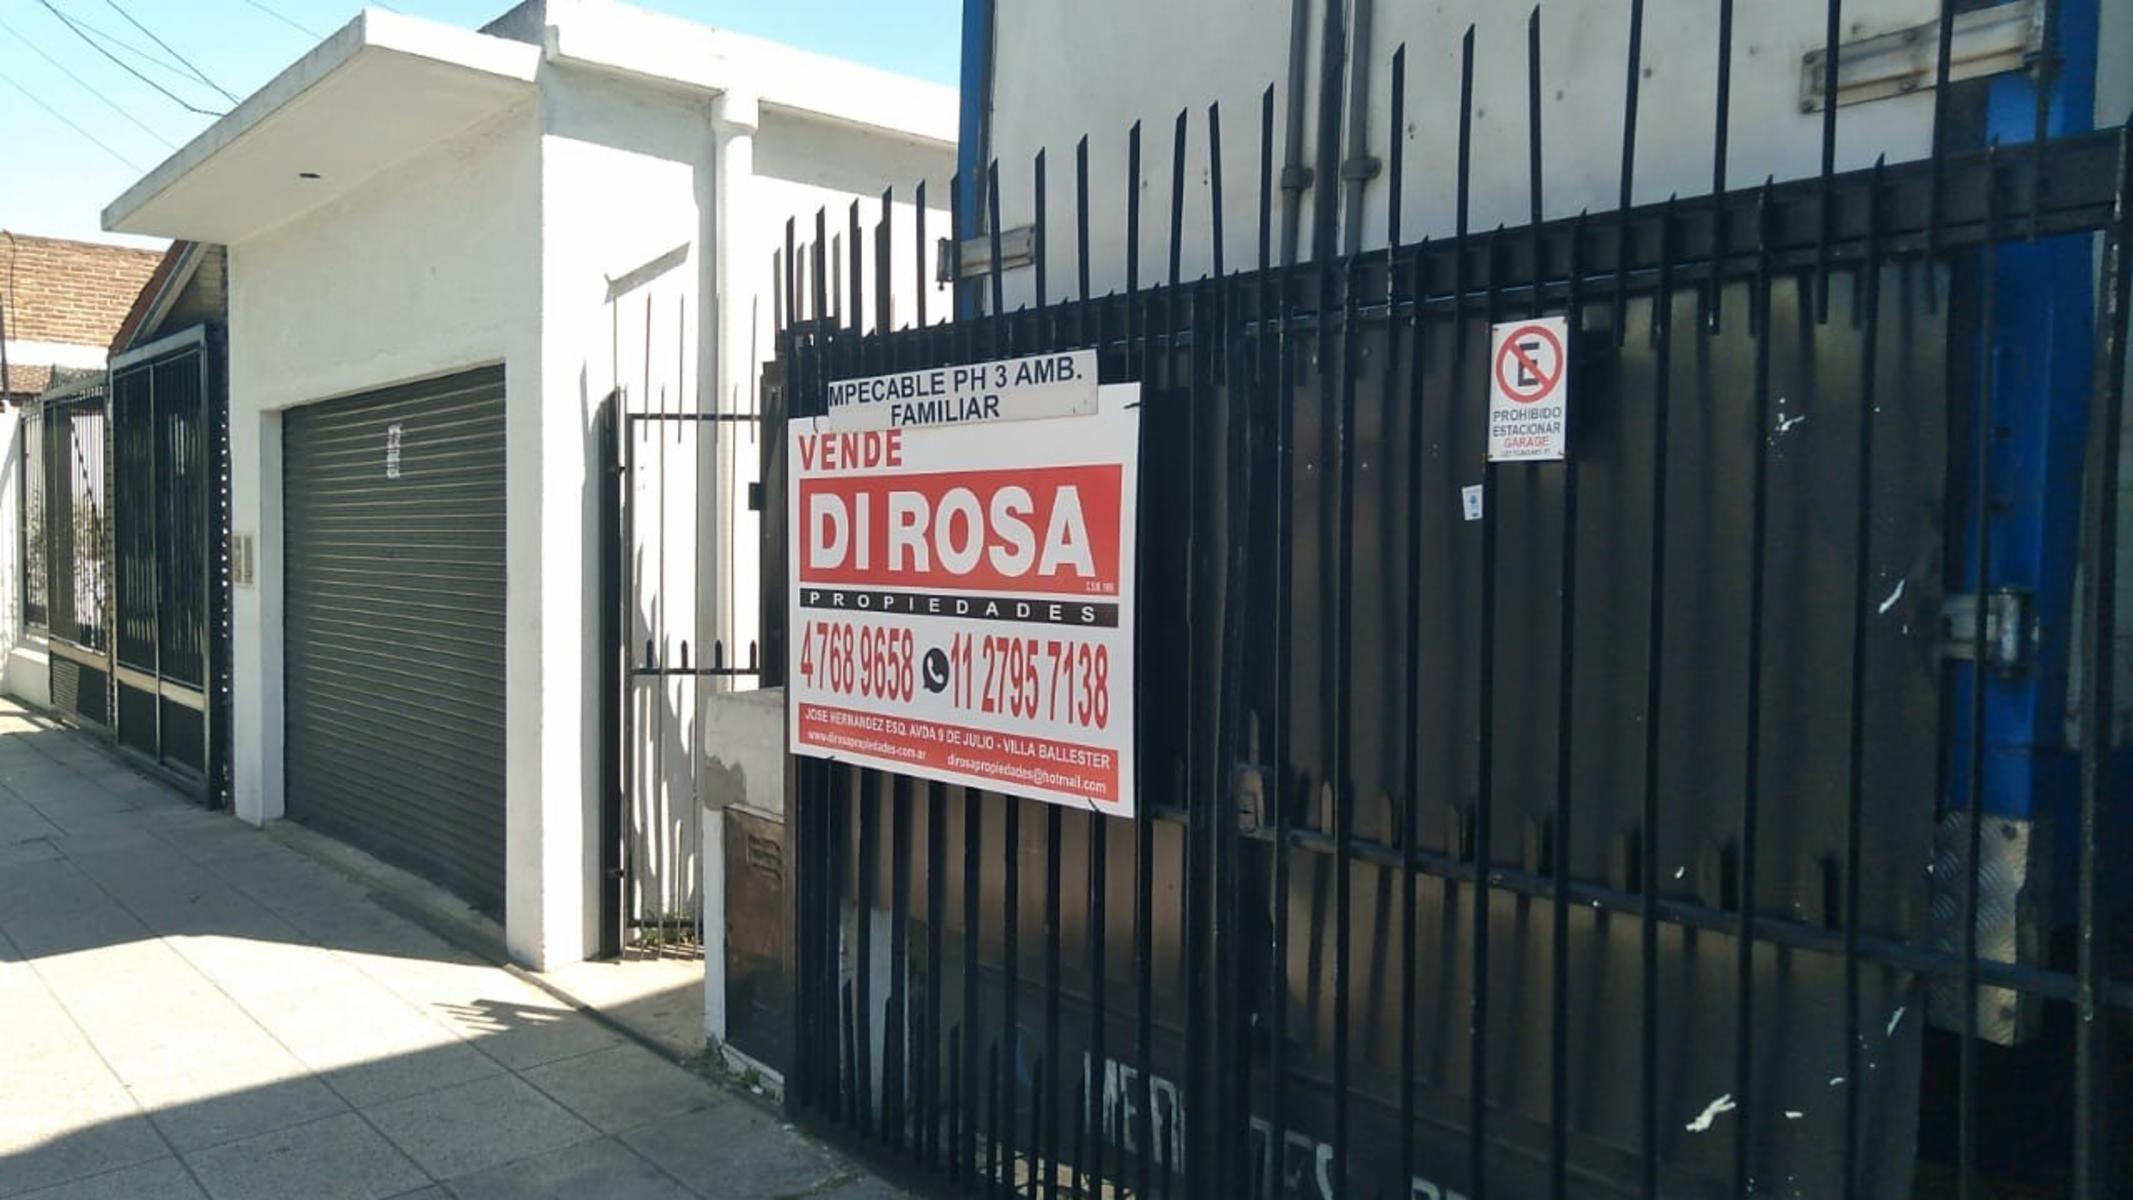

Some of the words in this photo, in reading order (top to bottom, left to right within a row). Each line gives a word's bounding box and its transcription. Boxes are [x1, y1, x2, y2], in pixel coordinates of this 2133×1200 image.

[828, 371, 946, 408] MPECABLE
[954, 365, 987, 393] PH
[995, 364, 1008, 389] 3
[1014, 356, 1083, 385] AMB.
[891, 394, 1000, 427] FAMILIAR
[1493, 406, 1562, 423] PROHIBIDO
[1492, 421, 1561, 437] ESTACIONAR
[1504, 435, 1550, 449] GARAGE
[799, 428, 902, 471] VENDE
[810, 492, 870, 571] DI
[887, 484, 1096, 579] ROSA
[810, 592, 1095, 621] PROPIEDADES
[860, 626, 914, 702] 9658
[951, 632, 972, 709] 11
[982, 635, 1039, 719] 2795
[1047, 640, 1109, 729] 7138
[804, 707, 829, 724] JOSE
[830, 711, 883, 732] HERNANDEZ
[909, 725, 936, 741] AVDA
[938, 730, 946, 743] 9
[947, 731, 962, 747] DE
[965, 734, 994, 751] JULIO
[1004, 739, 1035, 757] VILLA
[1038, 747, 1110, 769] BALLESTER
[808, 731, 926, 760] www.dirosapropiedades.com.ar
[948, 753, 1106, 793] dirosapropiedades@hotmail.com
